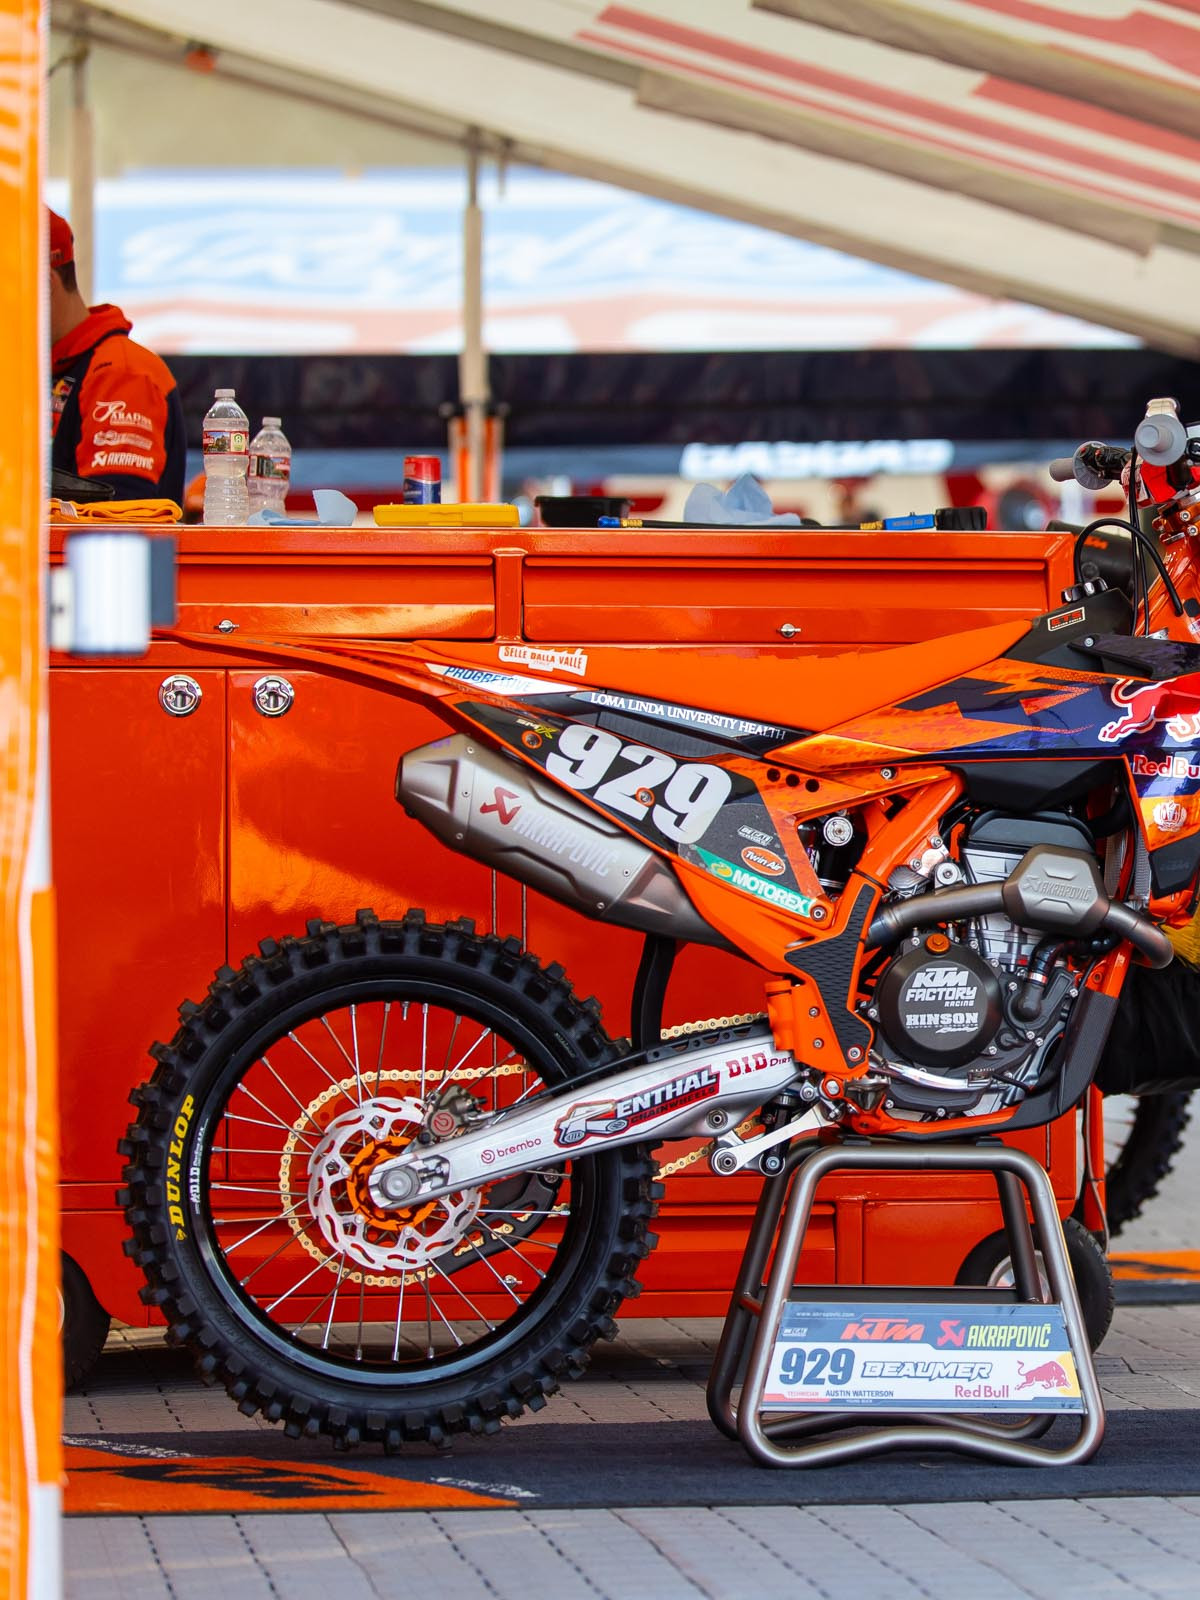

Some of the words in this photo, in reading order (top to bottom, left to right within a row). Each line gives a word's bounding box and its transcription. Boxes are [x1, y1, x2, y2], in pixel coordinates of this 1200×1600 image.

[503, 647, 527, 659] SELLE
[530, 652, 555, 662] DALLA
[559, 654, 582, 669] VALLE
[590, 693, 625, 709] LOMA
[628, 699, 664, 716] LINDA
[667, 706, 740, 730] UNIVERSITY
[738, 721, 787, 740] HEALTH
[1132, 754, 1173, 777] Red
[546, 724, 732, 844] 929
[745, 850, 767, 864] Twin
[767, 860, 782, 871] Air
[731, 870, 808, 913] MOTOREX
[912, 967, 969, 987] KTM
[905, 987, 977, 1002] FACTORY
[906, 1012, 978, 1026] HINSON
[497, 1137, 541, 1159] brembo
[166, 1094, 194, 1227] DUNLOP
[840, 1318, 925, 1341] KTM
[779, 1347, 855, 1386] 929
[861, 1361, 993, 1382] BEAUMER
[825, 1389, 851, 1397] AUSTIN
[852, 1390, 893, 1398] WATTERSON
[955, 1385, 981, 1398] Red
[984, 1385, 1009, 1398] Bull
